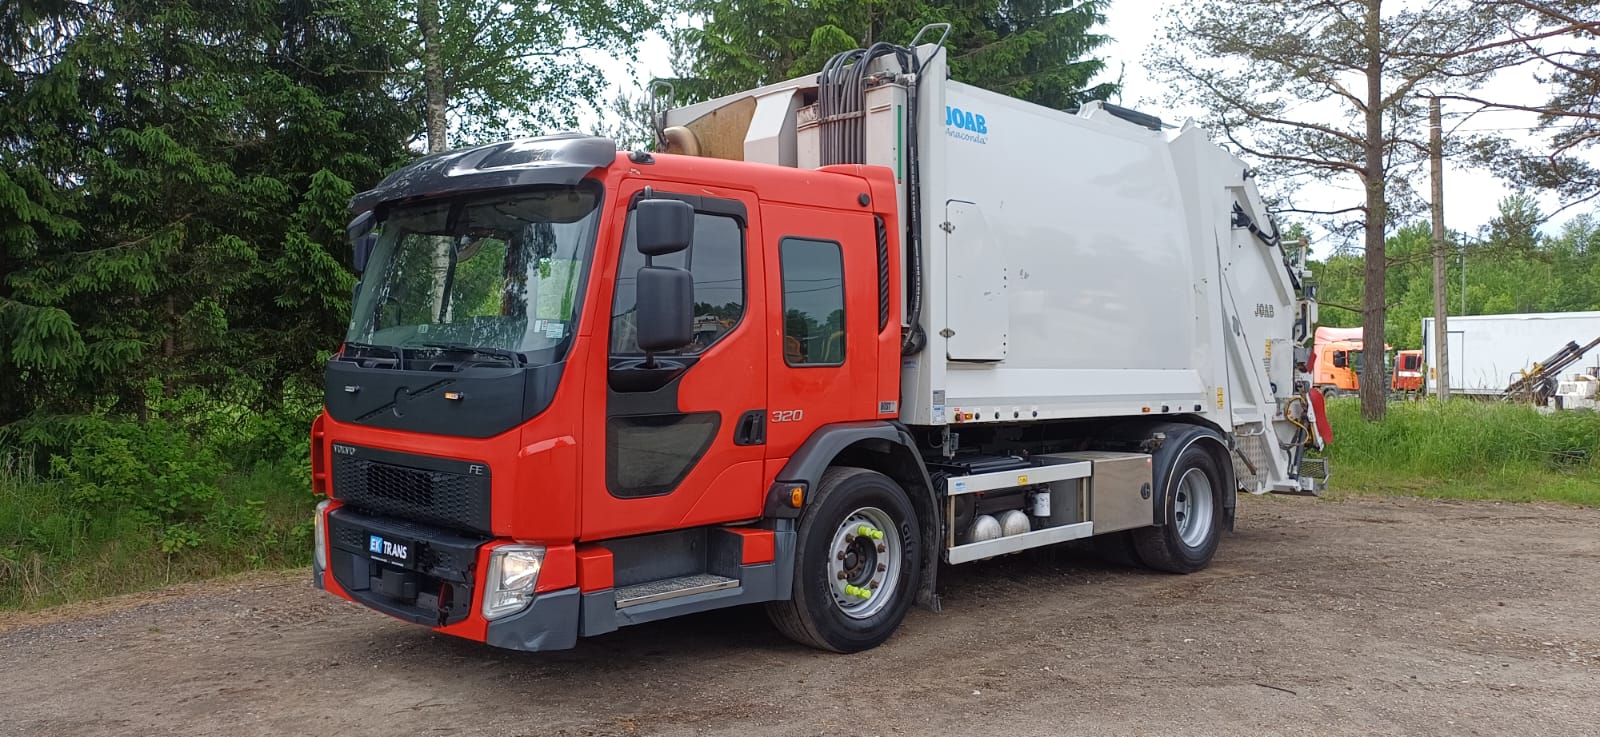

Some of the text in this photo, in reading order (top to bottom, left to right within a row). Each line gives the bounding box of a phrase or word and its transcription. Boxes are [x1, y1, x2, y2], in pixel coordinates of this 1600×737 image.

[945, 106, 987, 134] JOAB
[1254, 303, 1275, 318] JOAB
[771, 409, 803, 422] 320
[333, 444, 355, 455] VOLVO
[469, 464, 485, 475] FE
[370, 537, 408, 559] EK TRANS
